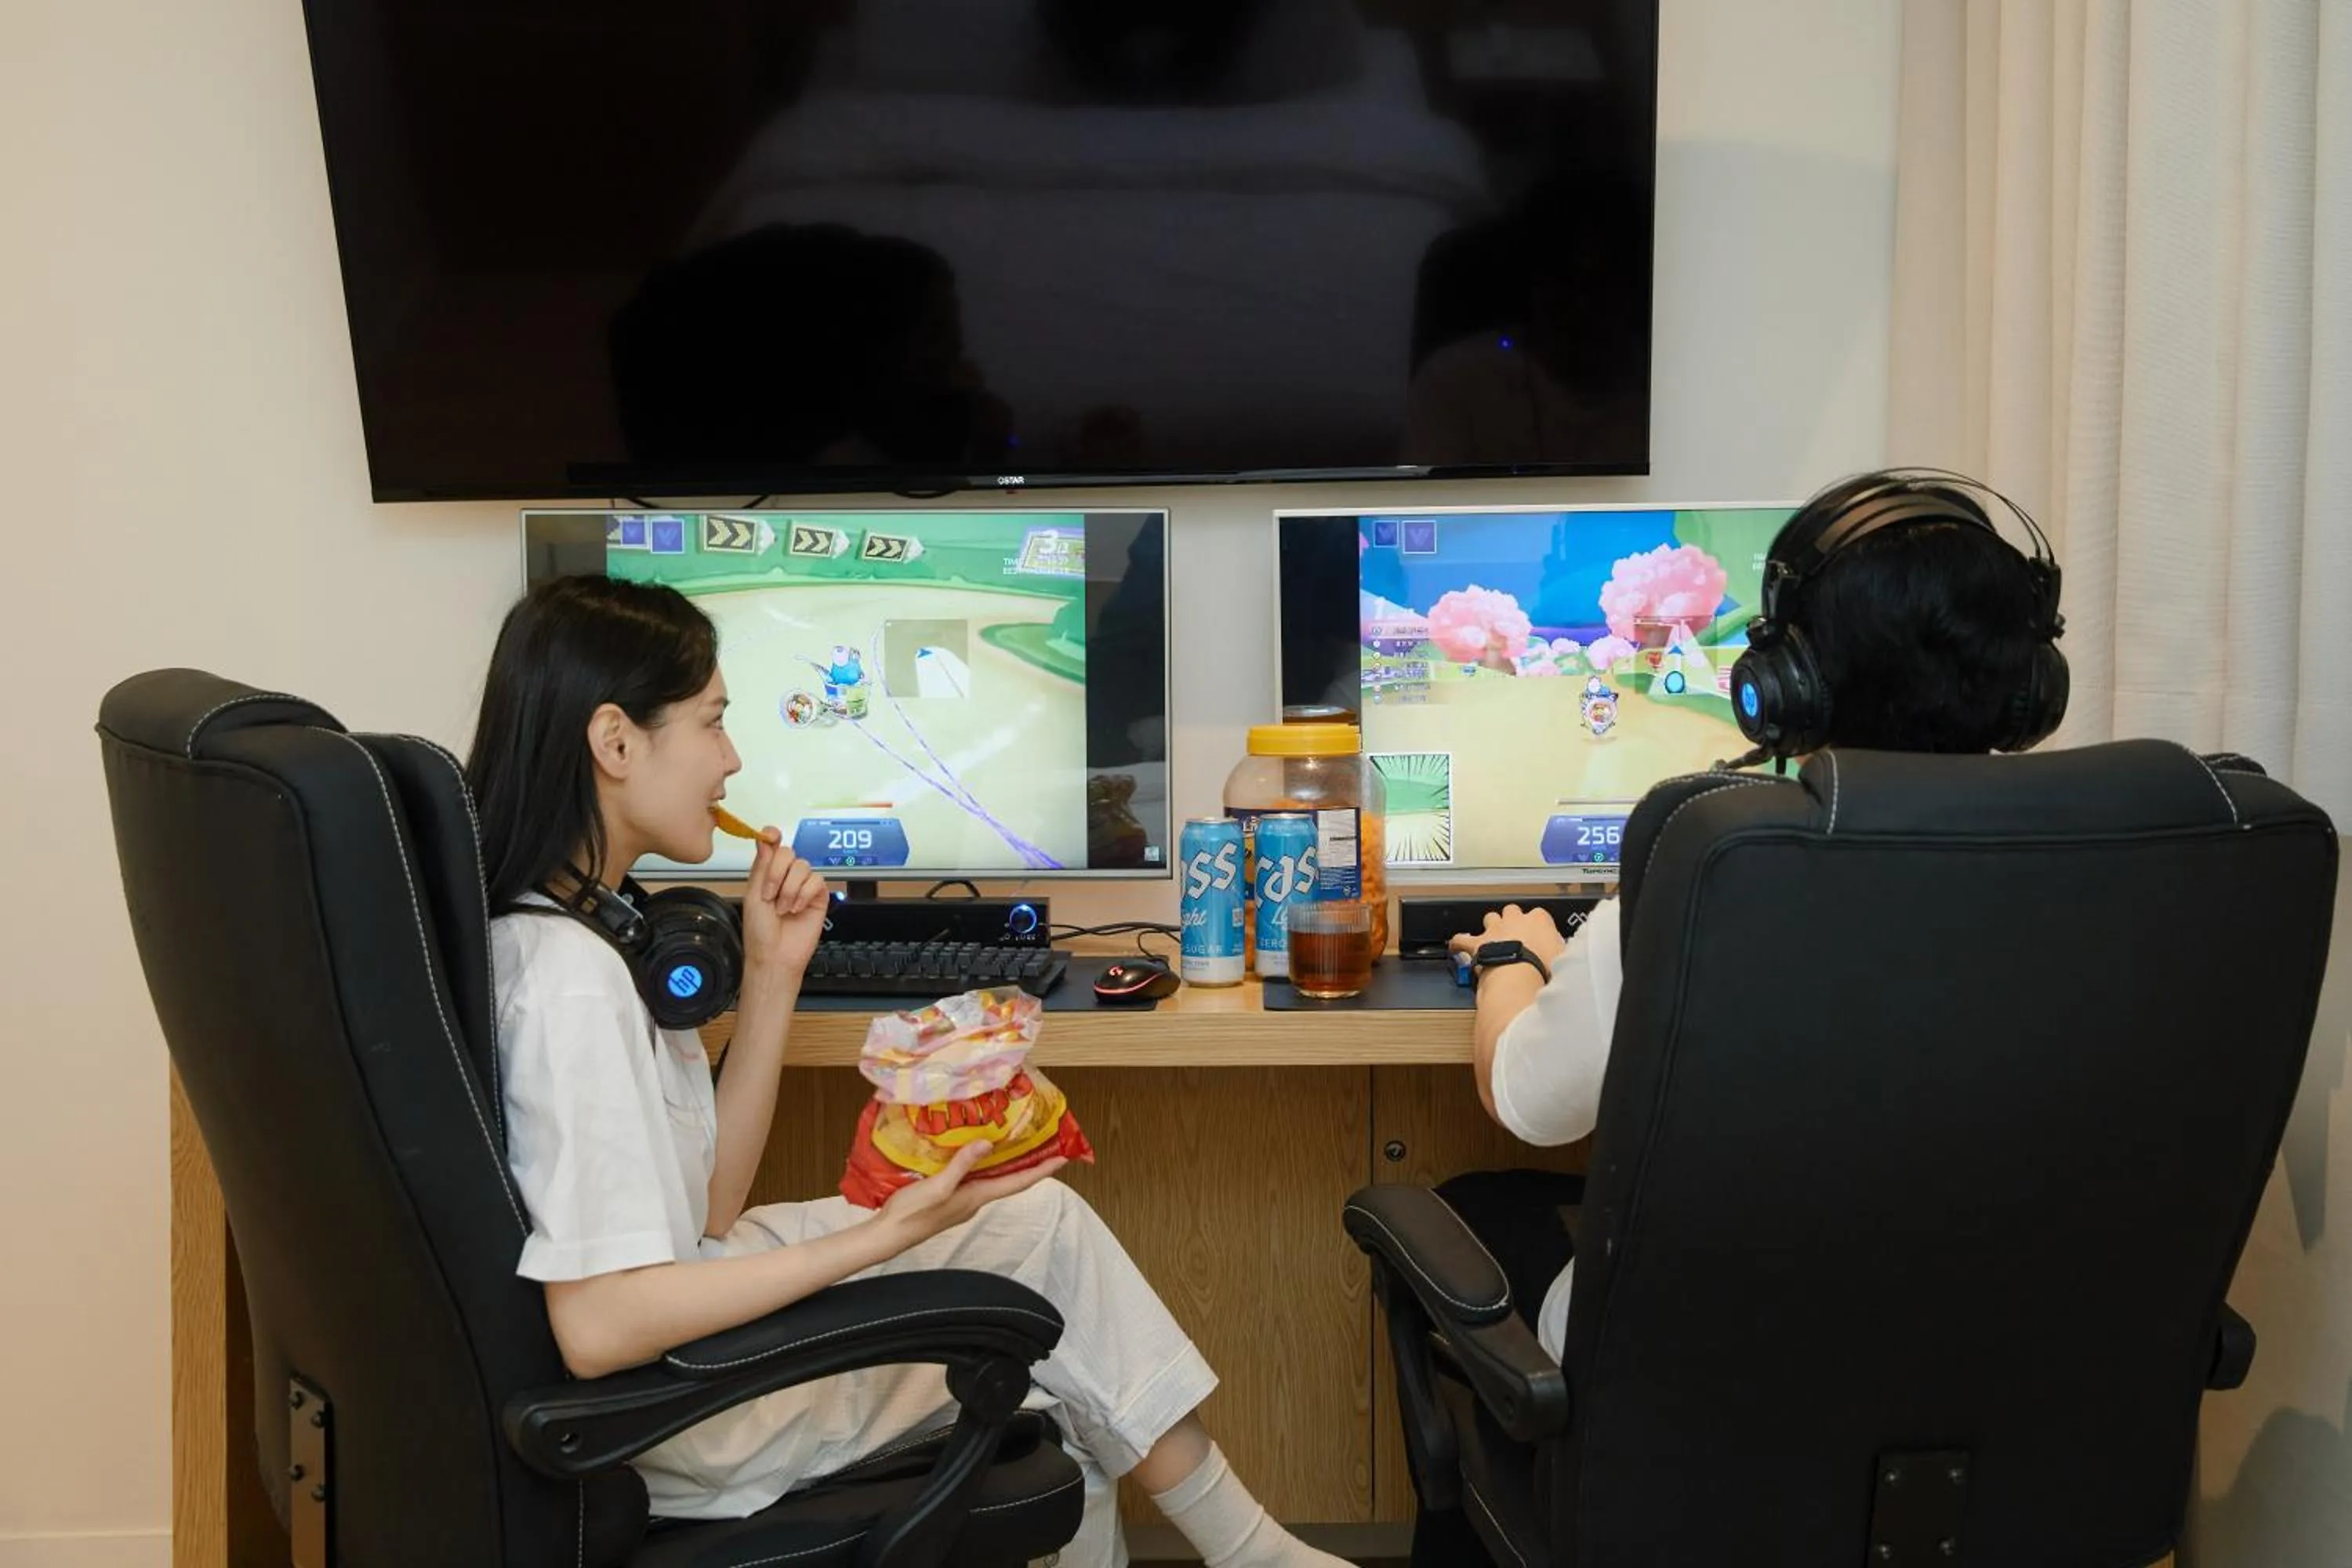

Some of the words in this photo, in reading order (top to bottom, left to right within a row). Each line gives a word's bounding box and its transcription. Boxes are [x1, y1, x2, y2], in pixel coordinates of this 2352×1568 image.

[828, 829, 872, 849] 209
[1577, 826, 1620, 845] 256
[1185, 944, 1223, 954] SUGAR
[670, 967, 701, 996] hp
